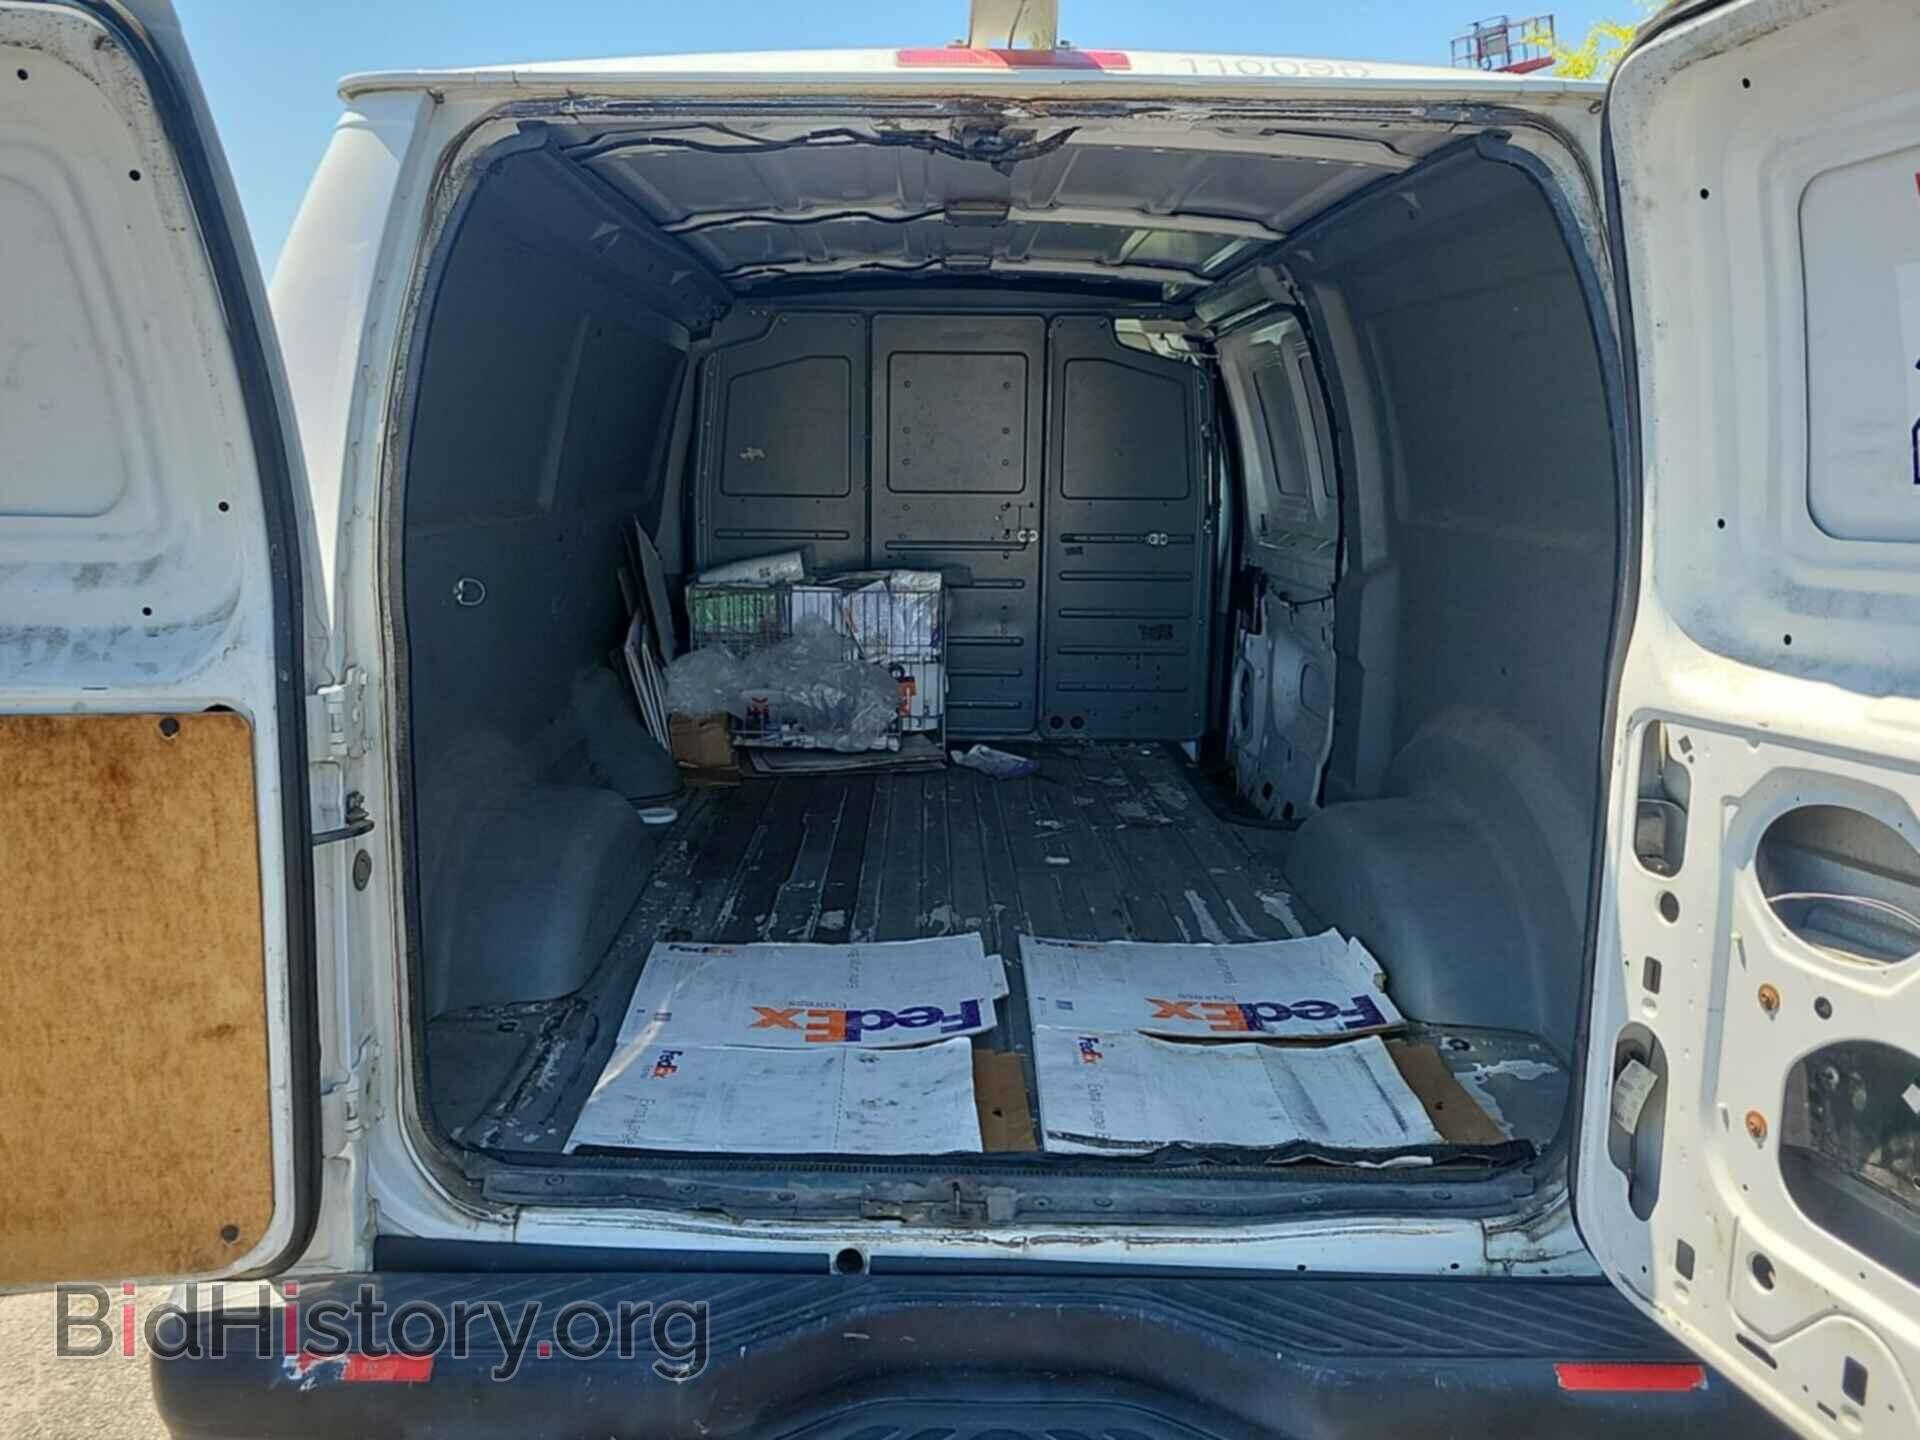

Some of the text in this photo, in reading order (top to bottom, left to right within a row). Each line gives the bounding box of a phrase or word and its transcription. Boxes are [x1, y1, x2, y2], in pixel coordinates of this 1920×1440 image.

[749, 1000, 982, 1042] FedEx
[1146, 994, 1387, 1032] FedEx
[655, 1050, 683, 1078] FedEx
